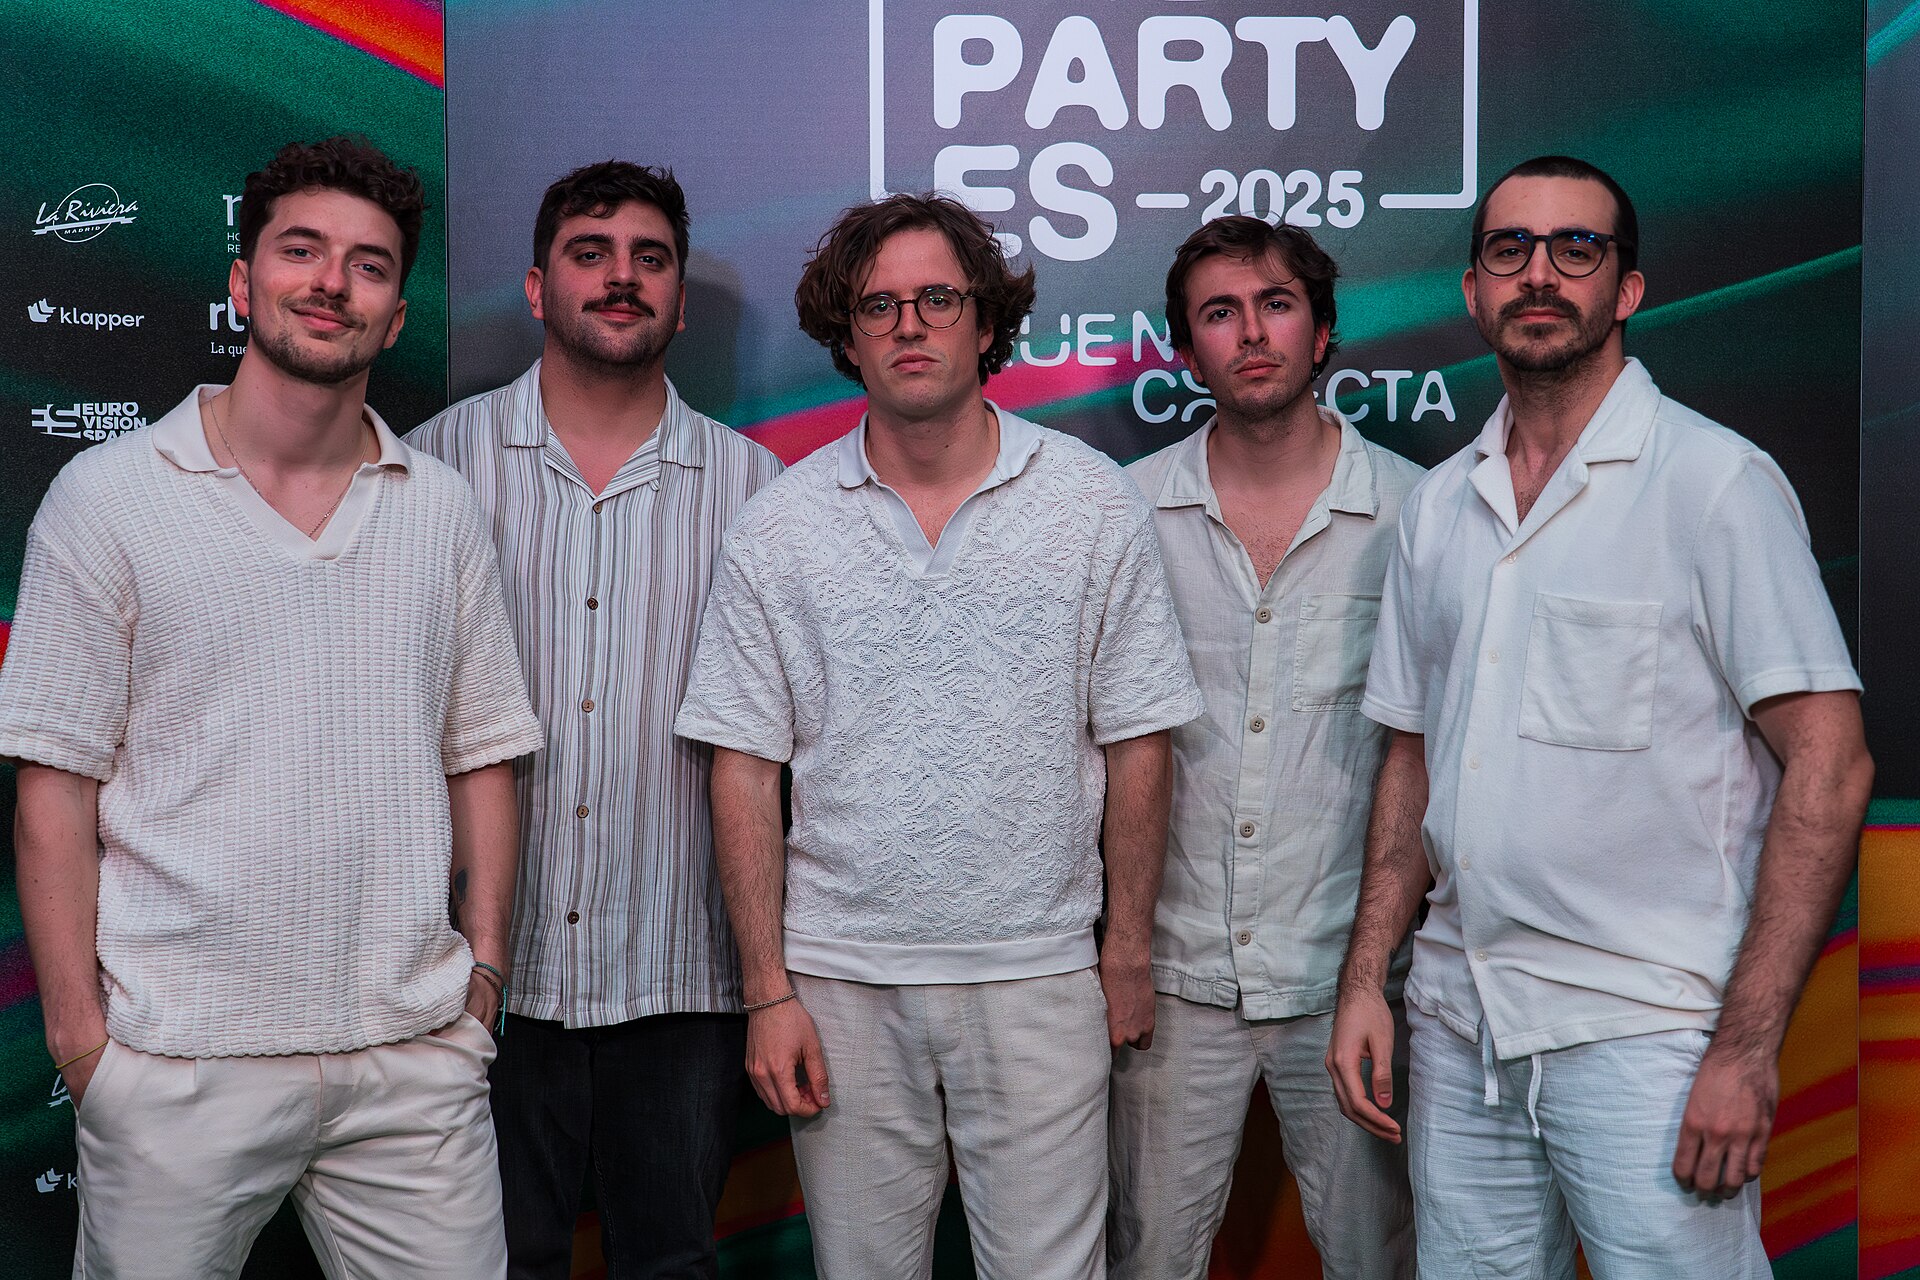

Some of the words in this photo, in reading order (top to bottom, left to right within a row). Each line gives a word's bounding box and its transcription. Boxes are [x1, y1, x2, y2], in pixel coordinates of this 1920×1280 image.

[933, 14, 1416, 131] PARTY
[934, 141, 1118, 262] ES
[1200, 169, 1365, 228] 2025
[36, 202, 59, 224] La
[65, 200, 138, 221] Riviera
[64, 225, 101, 235] MADRID
[60, 307, 145, 331] klapper
[211, 342, 225, 354] La
[1006, 313, 1117, 367] UE
[82, 402, 139, 417] EURO
[82, 416, 147, 430] VISION
[82, 429, 129, 441] SPA
